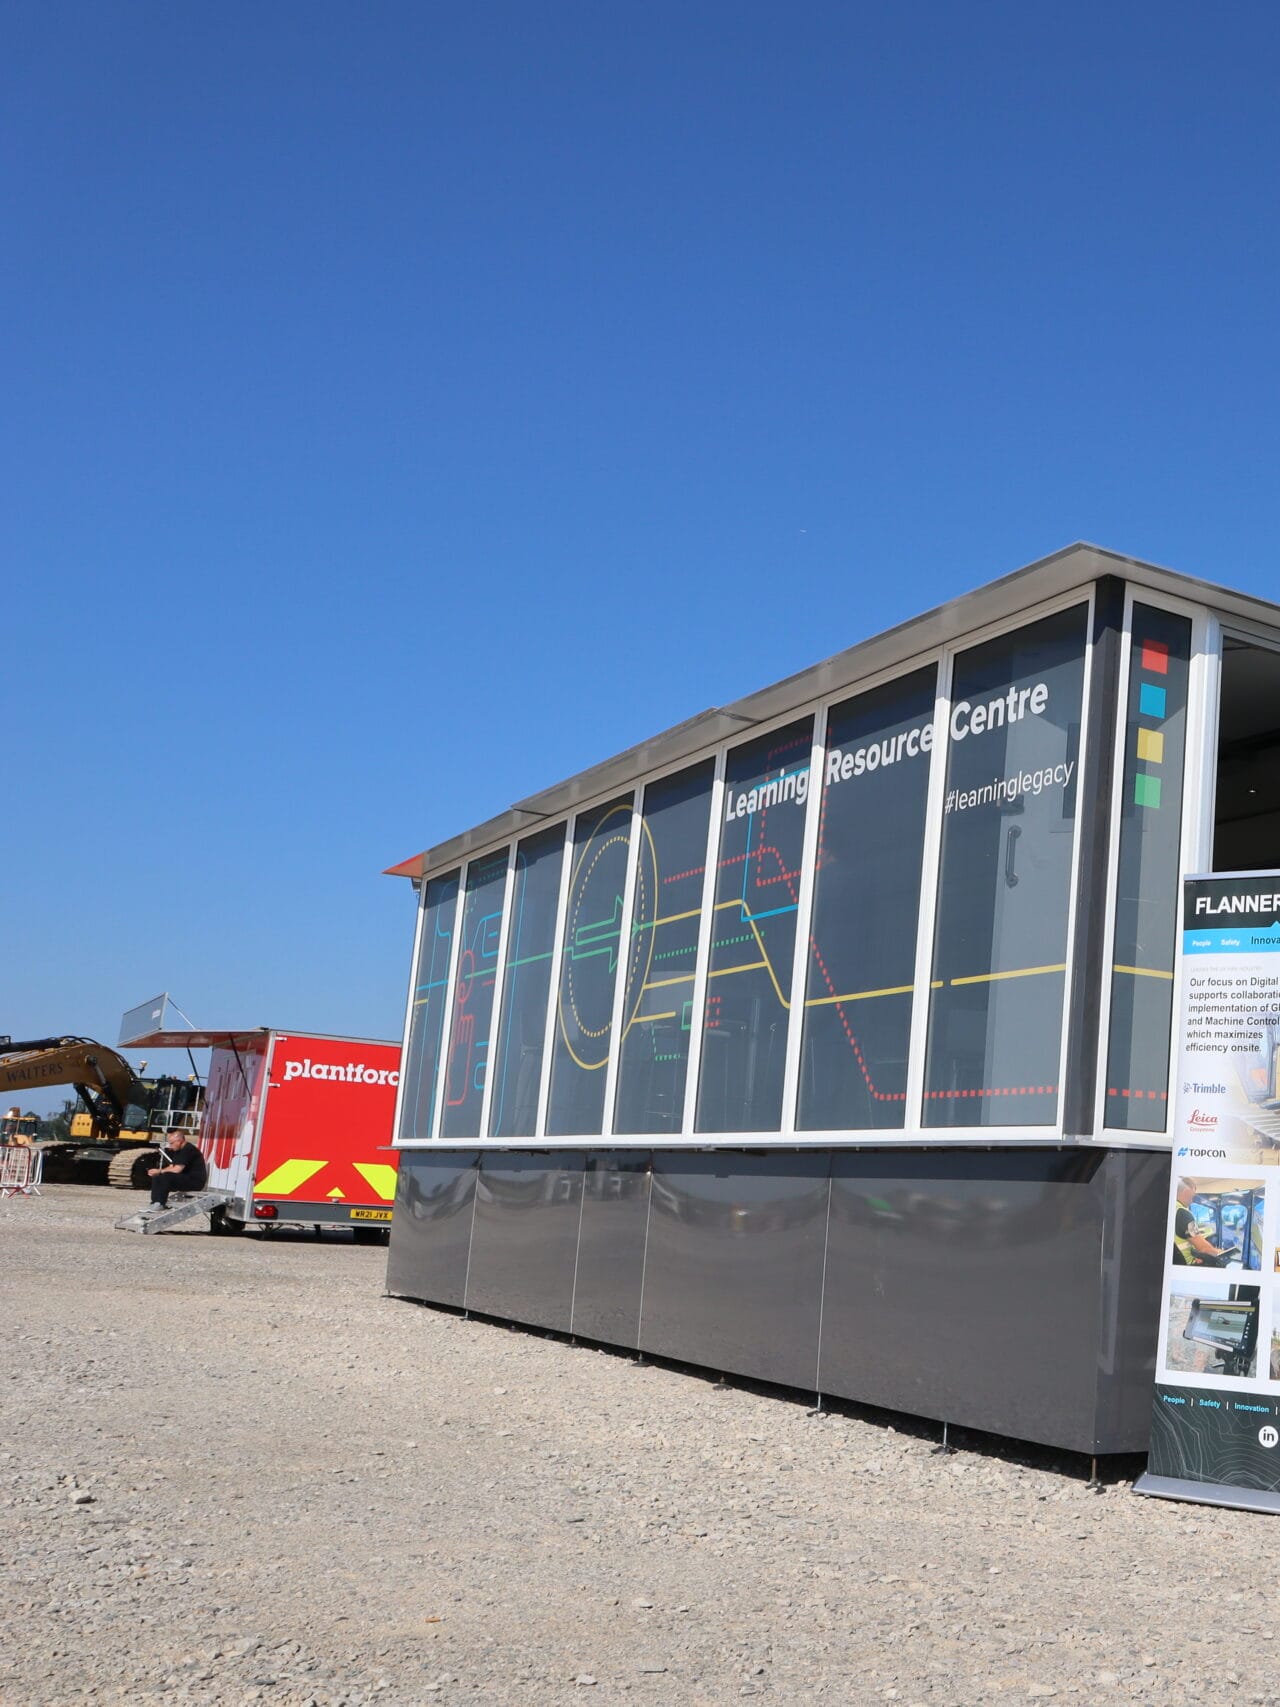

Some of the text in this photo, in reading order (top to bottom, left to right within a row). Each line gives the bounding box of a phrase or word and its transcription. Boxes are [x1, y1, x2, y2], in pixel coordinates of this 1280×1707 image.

[726, 682, 1049, 822] Learning Resource Centre
[944, 761, 1075, 815] #learninglegacy
[1192, 940, 1211, 948] People
[1221, 938, 1240, 947] Safety
[1190, 977, 1205, 987] Our
[1207, 977, 1233, 987] focus
[1250, 976, 1279, 988] Digital
[1189, 990, 1228, 1002] supports
[1188, 1003, 1258, 1014] implementation
[1260, 1003, 1269, 1012] of
[1187, 1016, 1280, 1026] and Machine Control
[1186, 1029, 1264, 1039] which maximizes
[1185, 1043, 1262, 1054] efficiency onsite.
[7, 1063, 63, 1082] WALTERS
[1193, 1083, 1226, 1094] Trimble
[1187, 1109, 1219, 1126] Leica
[1189, 1148, 1226, 1158] TOPCON
[1163, 1395, 1186, 1405] People
[1199, 1399, 1221, 1409] Safety
[1234, 1402, 1270, 1414] Innovation
